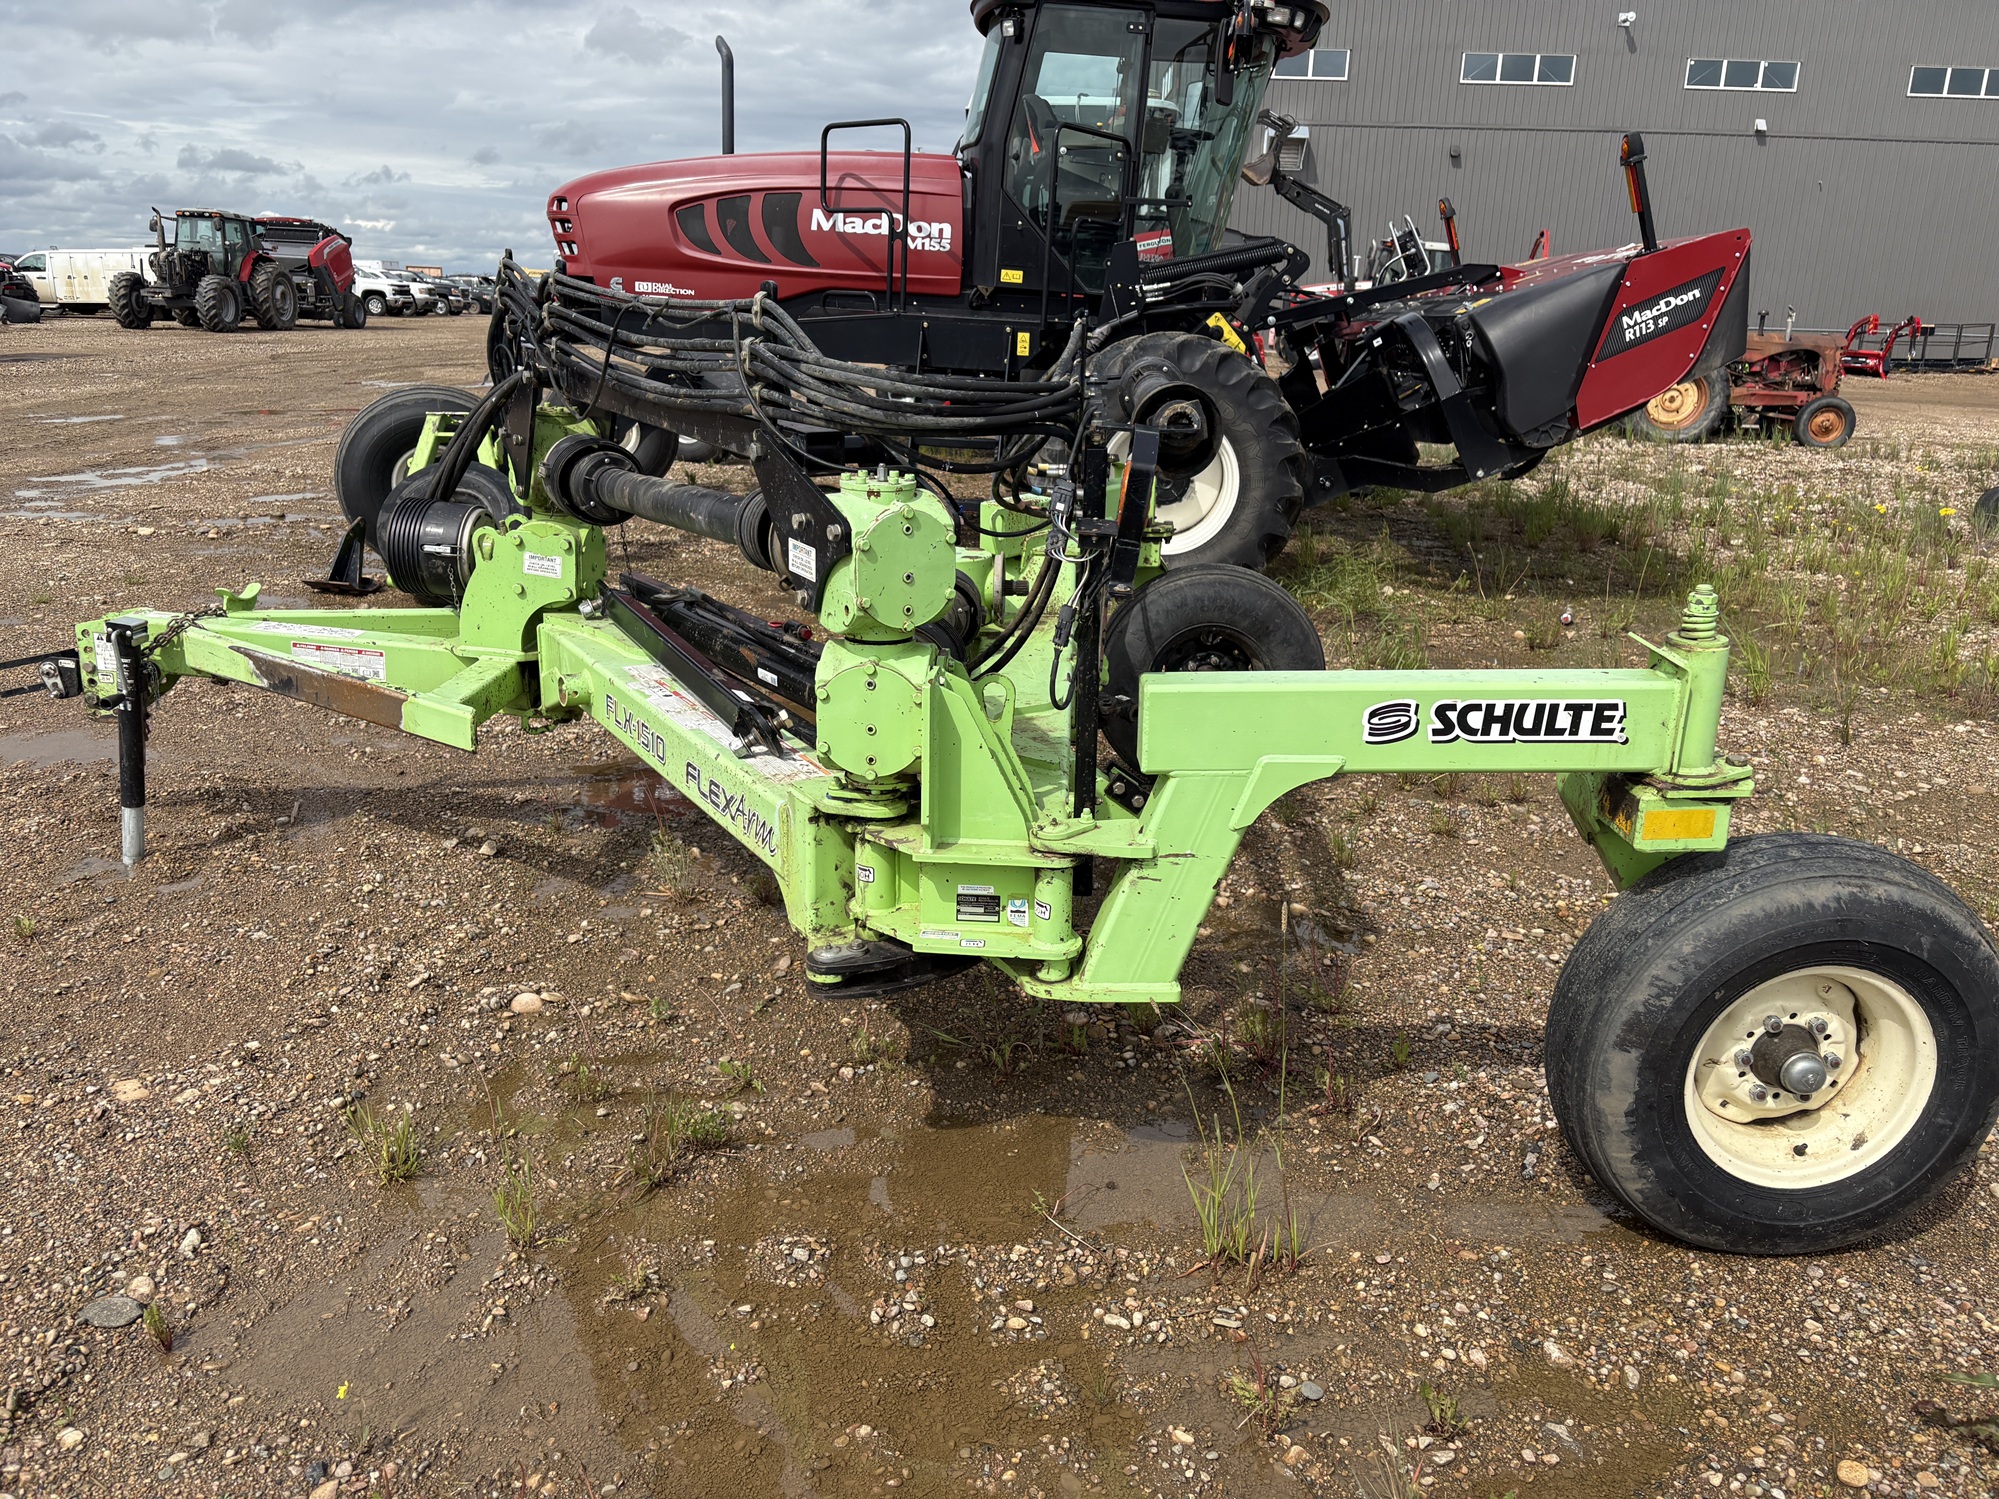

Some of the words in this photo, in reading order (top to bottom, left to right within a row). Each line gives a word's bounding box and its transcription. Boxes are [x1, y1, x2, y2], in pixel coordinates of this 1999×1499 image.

[811, 208, 952, 239] MacDon
[907, 237, 951, 251] M155
[1138, 237, 1171, 249] FERGUON
[652, 282, 672, 290] DUAL
[652, 287, 694, 296] DIRECTION
[1622, 288, 1701, 329] MacDon
[1625, 321, 1654, 342] R113
[1658, 316, 1669, 328] SP
[529, 554, 557, 563] IMPORTANT
[606, 693, 666, 766] FLX-1510
[1430, 702, 1622, 739] SCHULTE
[1913, 965, 1965, 1029] HARROW
